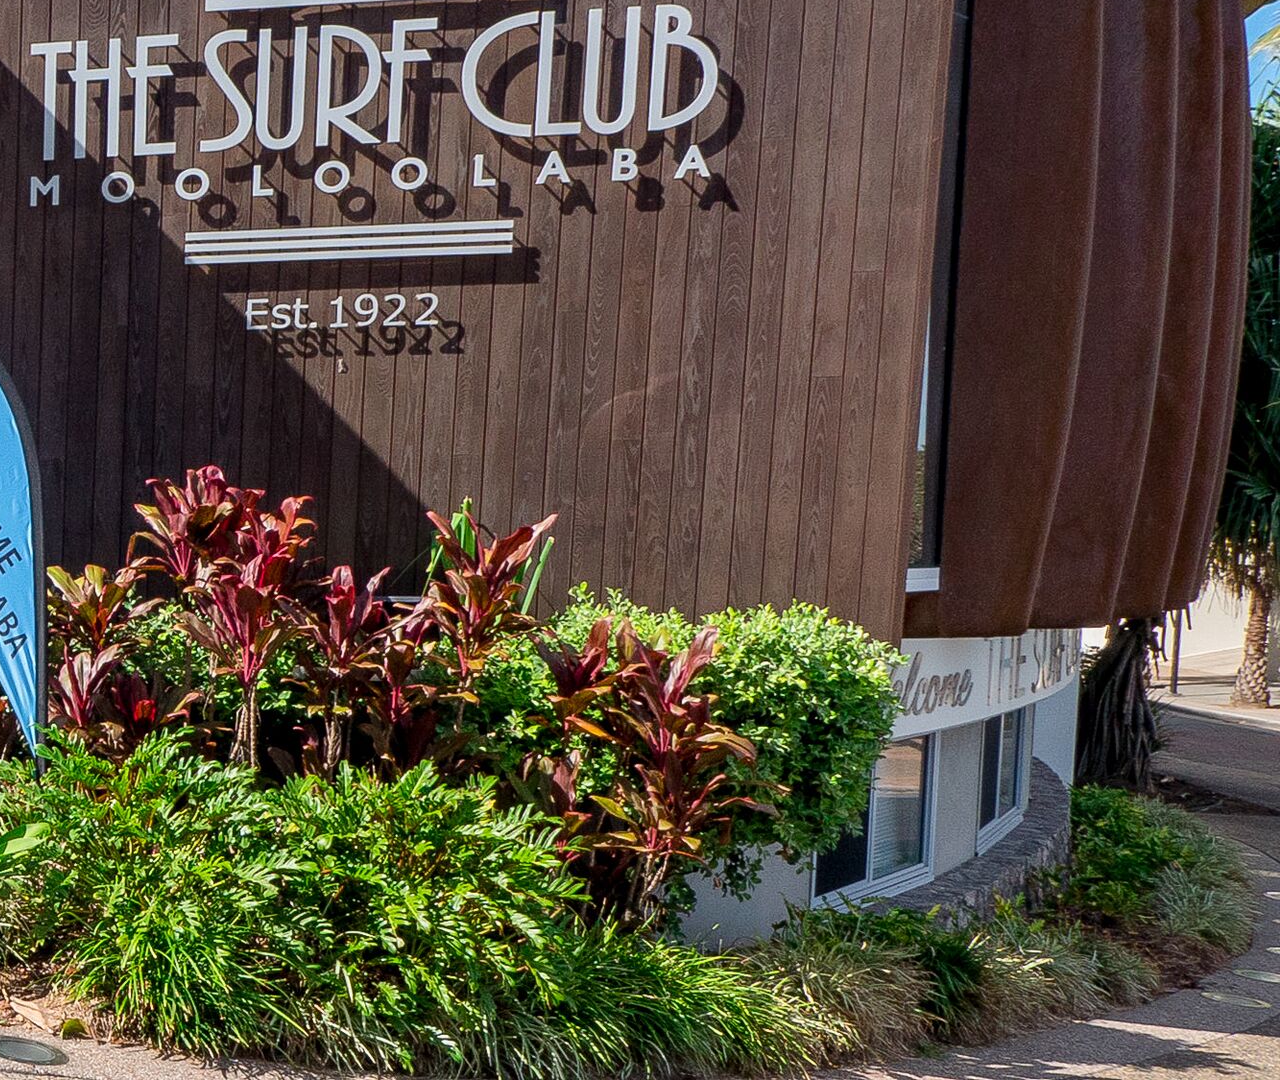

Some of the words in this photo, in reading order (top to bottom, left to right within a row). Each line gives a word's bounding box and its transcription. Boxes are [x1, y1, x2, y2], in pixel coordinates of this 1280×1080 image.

[30, 34, 179, 161] THE
[200, 17, 439, 153] SURF
[460, 4, 720, 138] CLUB
[29, 144, 711, 208] MOOLOOLABA
[245, 297, 318, 331] Est.
[330, 292, 440, 328] 1922
[890, 651, 974, 717] elcome
